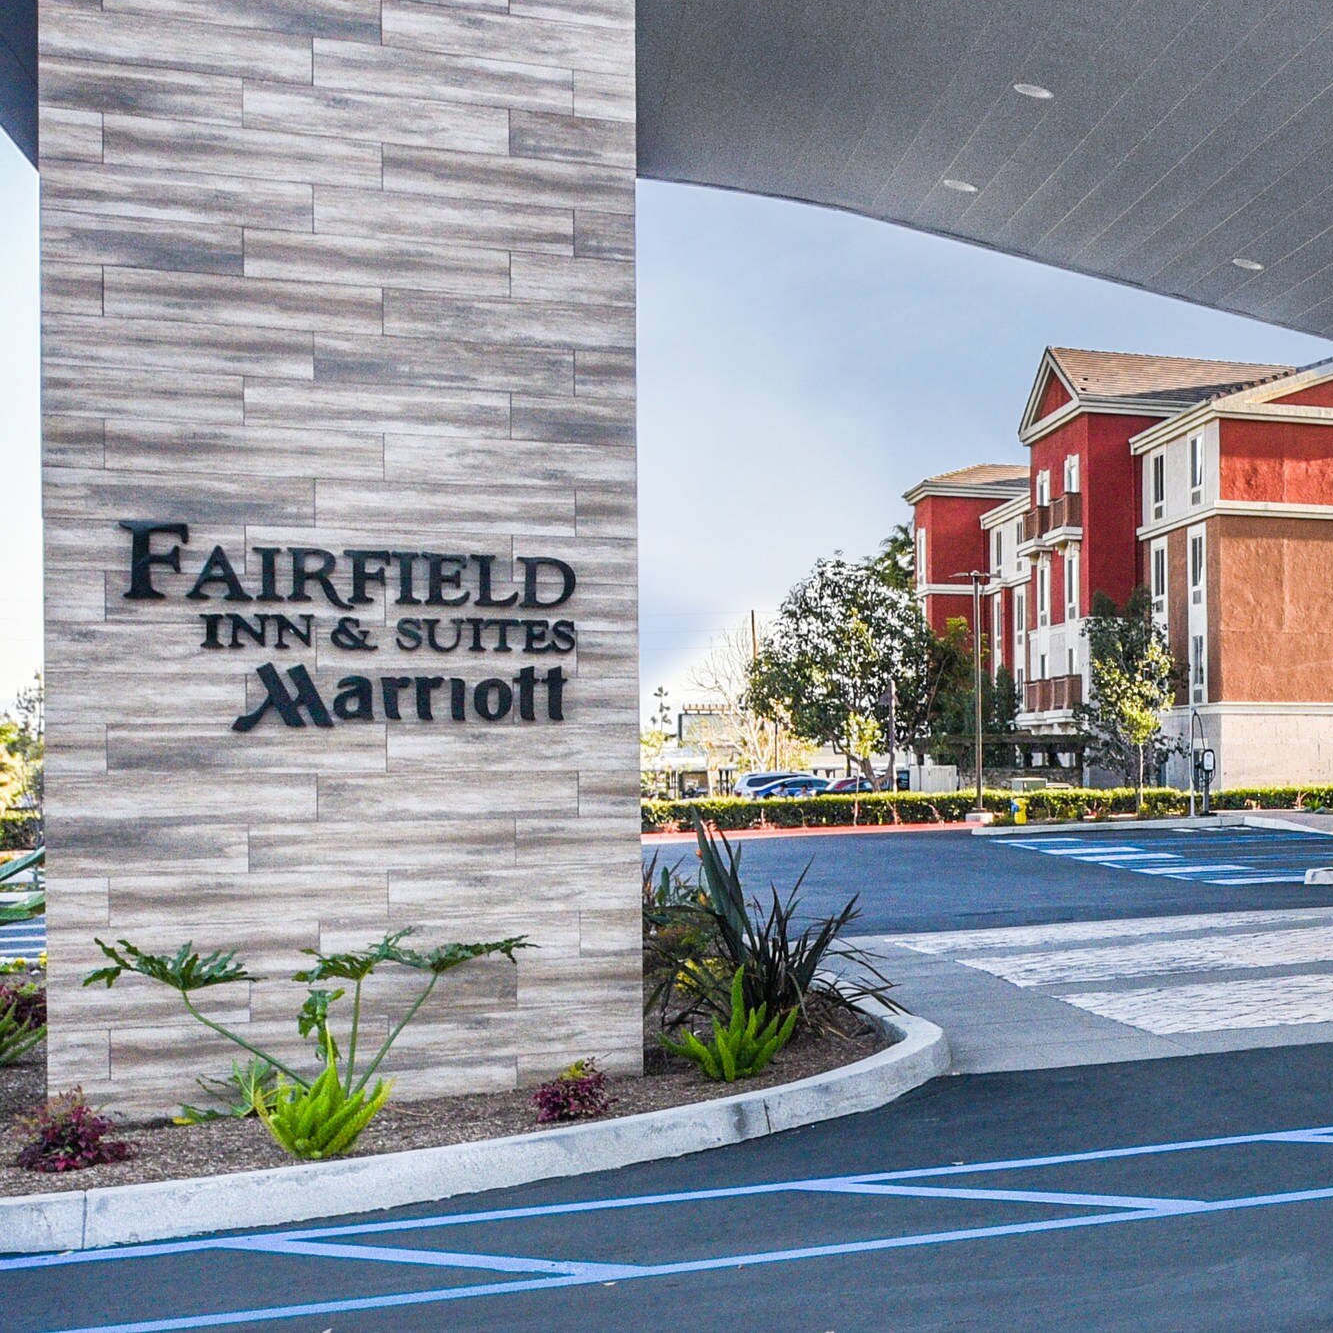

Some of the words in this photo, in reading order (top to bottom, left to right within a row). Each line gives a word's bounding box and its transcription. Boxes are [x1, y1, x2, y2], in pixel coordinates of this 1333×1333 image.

[118, 519, 577, 610] FAIRFIELD
[199, 613, 315, 650] INN
[331, 616, 379, 652] &
[396, 617, 577, 654] SUITES
[231, 662, 568, 732] Marriott
